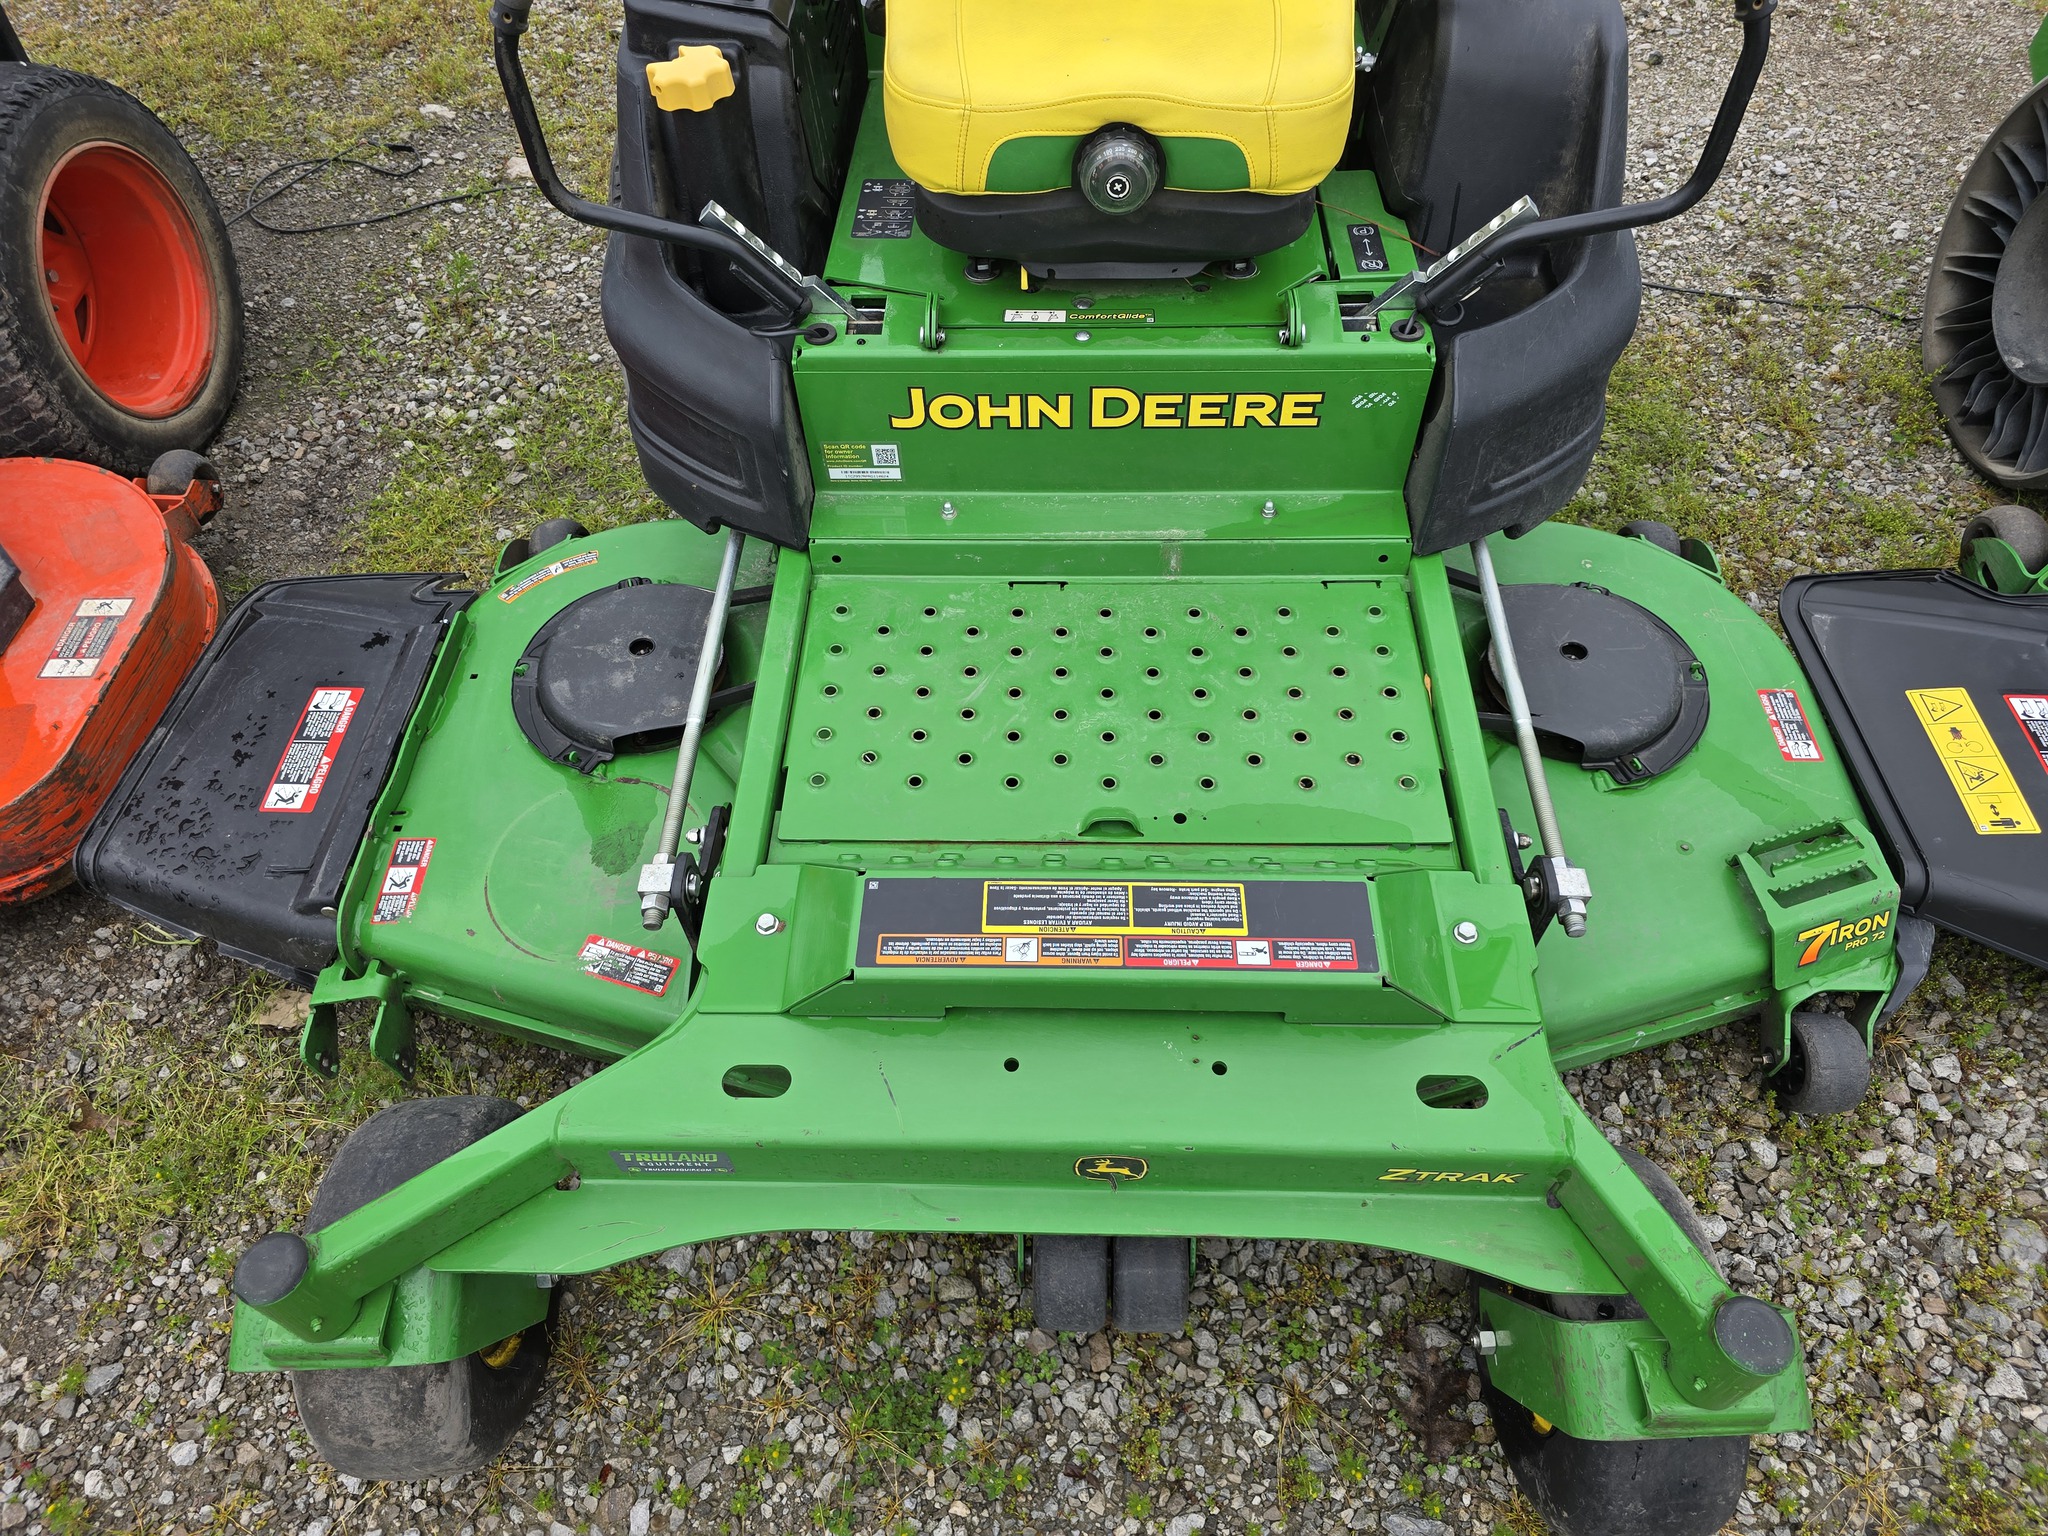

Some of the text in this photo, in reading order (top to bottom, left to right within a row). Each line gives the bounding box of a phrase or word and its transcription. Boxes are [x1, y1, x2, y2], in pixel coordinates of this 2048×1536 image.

[888, 386, 1072, 430] JOHN
[1089, 385, 1326, 428] DEERE
[1760, 694, 1773, 714] PELIGRO
[335, 707, 353, 733] DANGER
[1773, 727, 1786, 746] DANGER
[309, 764, 329, 794] PELIGRO
[420, 844, 432, 867] DANGER
[606, 940, 631, 953] DANGER
[1845, 930, 1886, 951] PRO 72
[619, 1153, 718, 1162] TRULAND
[1378, 1168, 1526, 1184] ZTRAK
